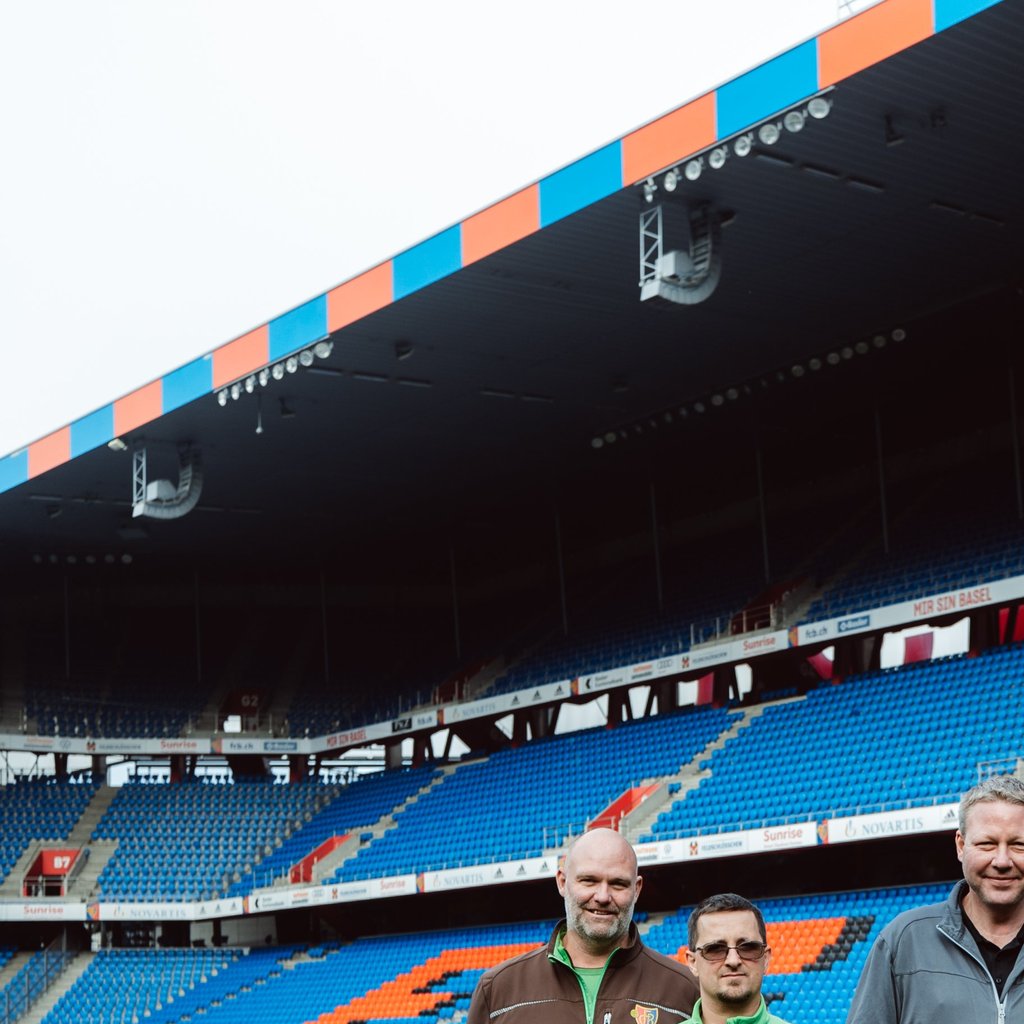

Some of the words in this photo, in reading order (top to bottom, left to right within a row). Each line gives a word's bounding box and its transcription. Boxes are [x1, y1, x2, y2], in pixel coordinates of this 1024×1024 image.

[913, 600, 934, 617] MIR
[936, 594, 956, 612] SIN
[959, 587, 992, 606] BASEL
[743, 636, 776, 651] Sunrise
[160, 739, 197, 749] Sunrise
[862, 817, 924, 835] NOVARTIS
[763, 827, 803, 842] Sunrise
[53, 856, 70, 869] B7
[444, 873, 484, 885] NOVARTIS
[23, 905, 64, 915] Sunrise
[130, 908, 187, 918] NOVARTIS
